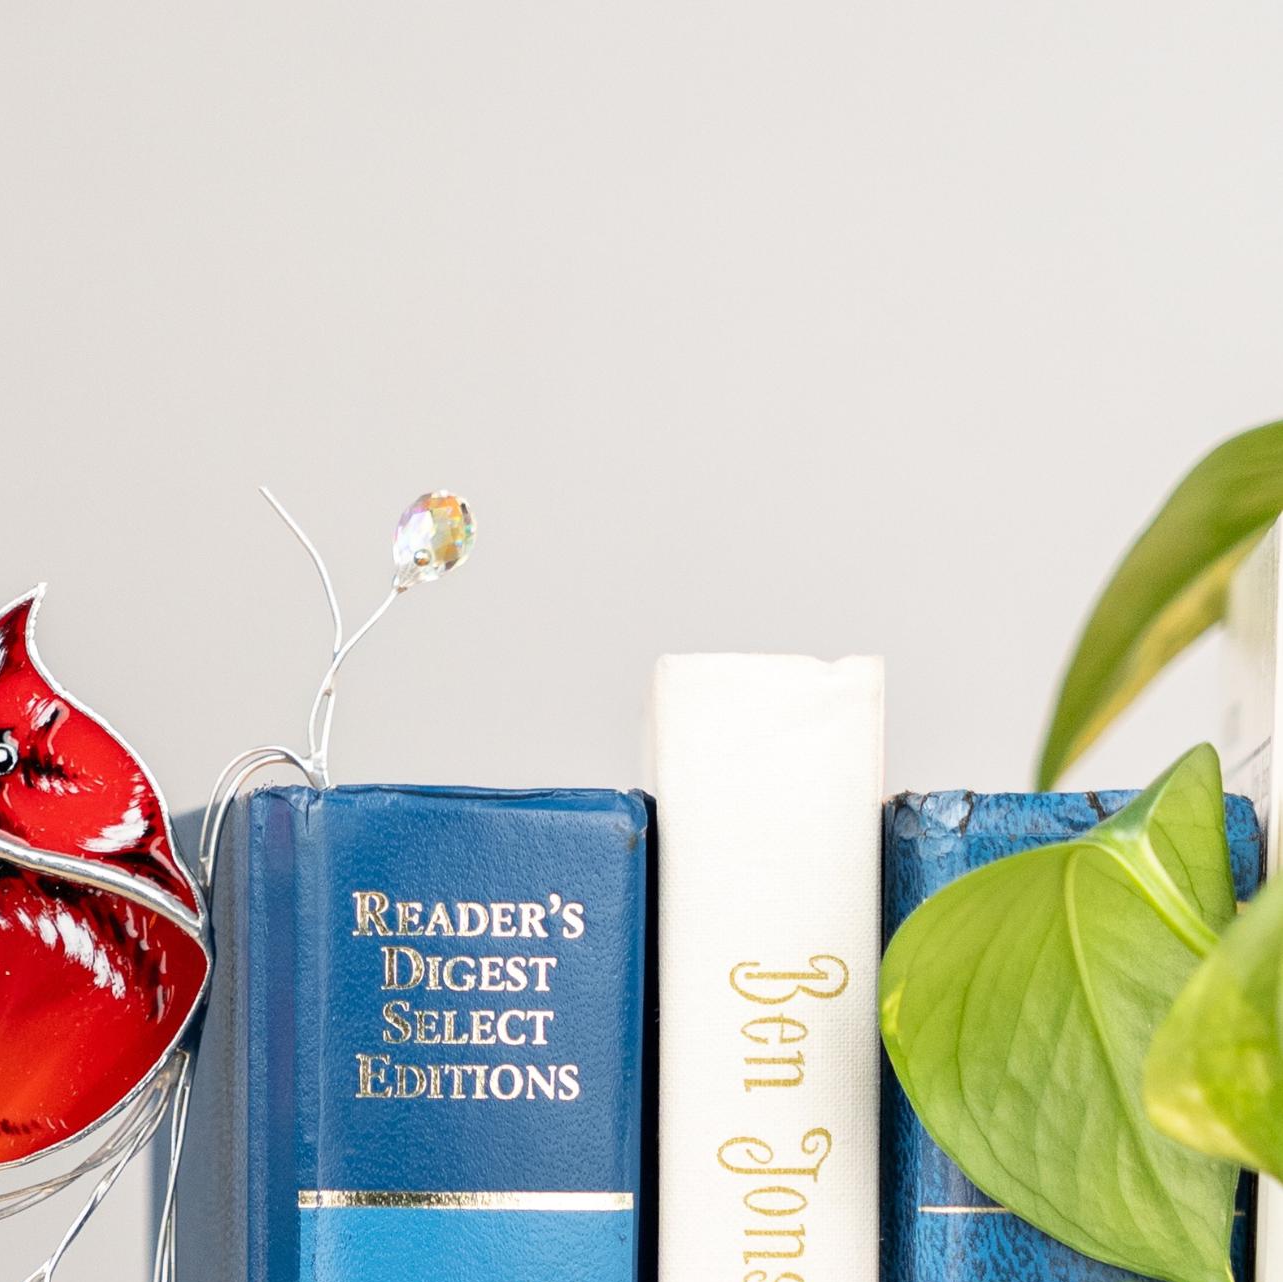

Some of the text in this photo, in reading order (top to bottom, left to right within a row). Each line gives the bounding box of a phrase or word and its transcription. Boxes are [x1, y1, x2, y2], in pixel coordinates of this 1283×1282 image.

[352, 891, 585, 939] READER'S
[380, 946, 557, 992] DIGEST
[382, 1000, 554, 1046] SELECT
[728, 954, 849, 1092] Ben
[355, 1053, 580, 1100] EDITIONS
